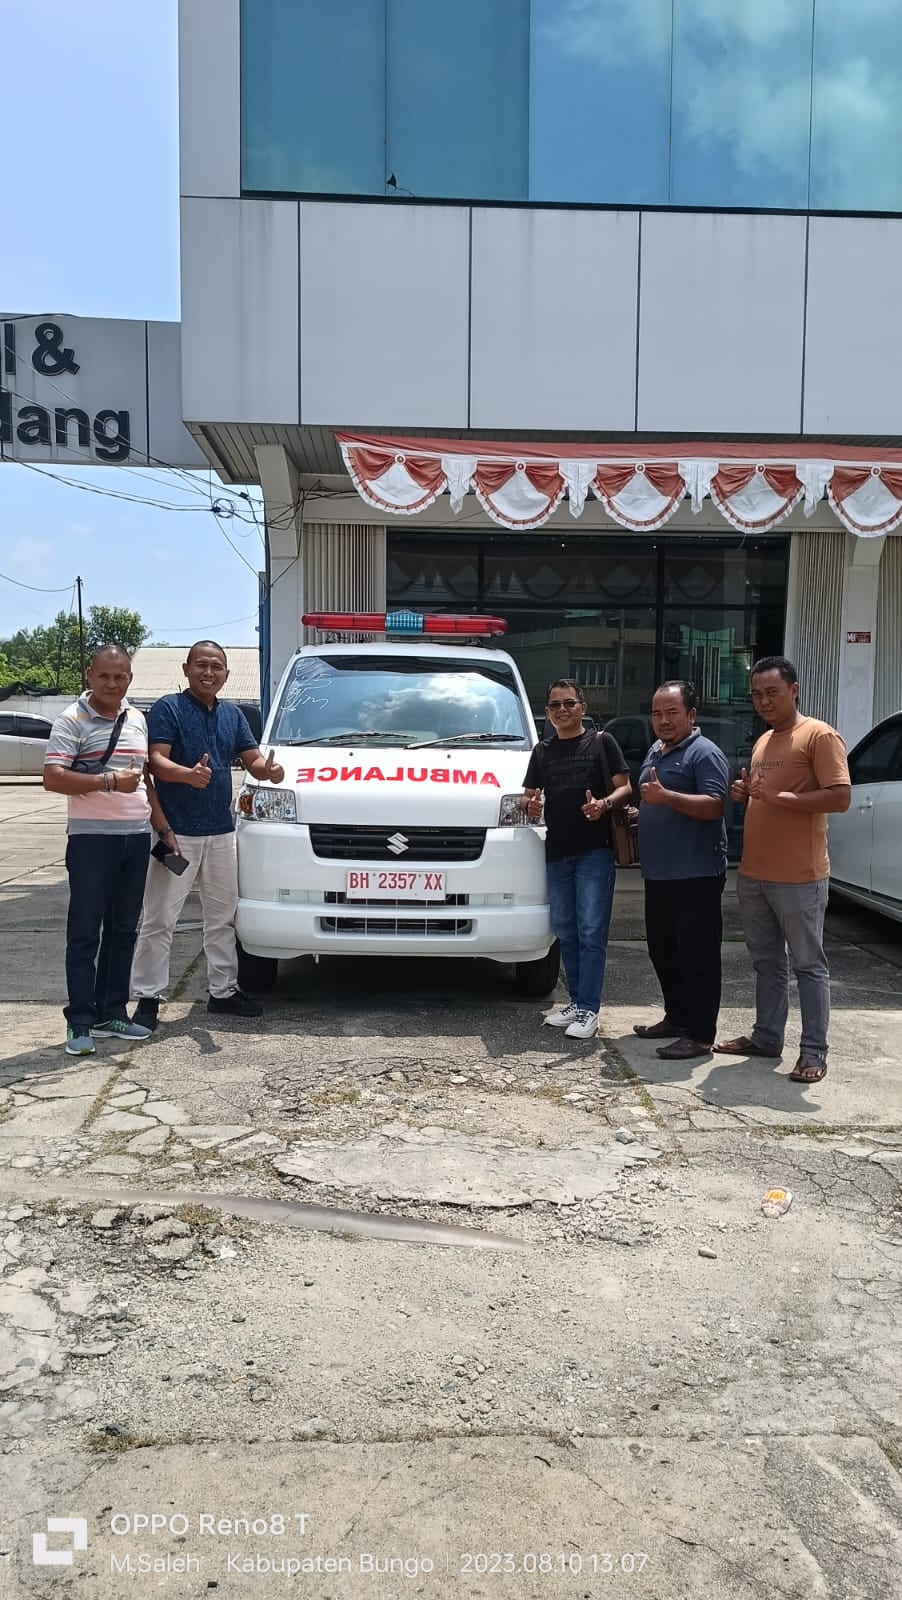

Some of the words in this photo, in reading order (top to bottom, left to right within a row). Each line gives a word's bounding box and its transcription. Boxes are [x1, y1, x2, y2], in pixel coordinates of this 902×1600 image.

[32, 323, 80, 377] &
[349, 872, 369, 889] BH
[378, 872, 417, 890] 2357
[424, 873, 443, 890] XX
